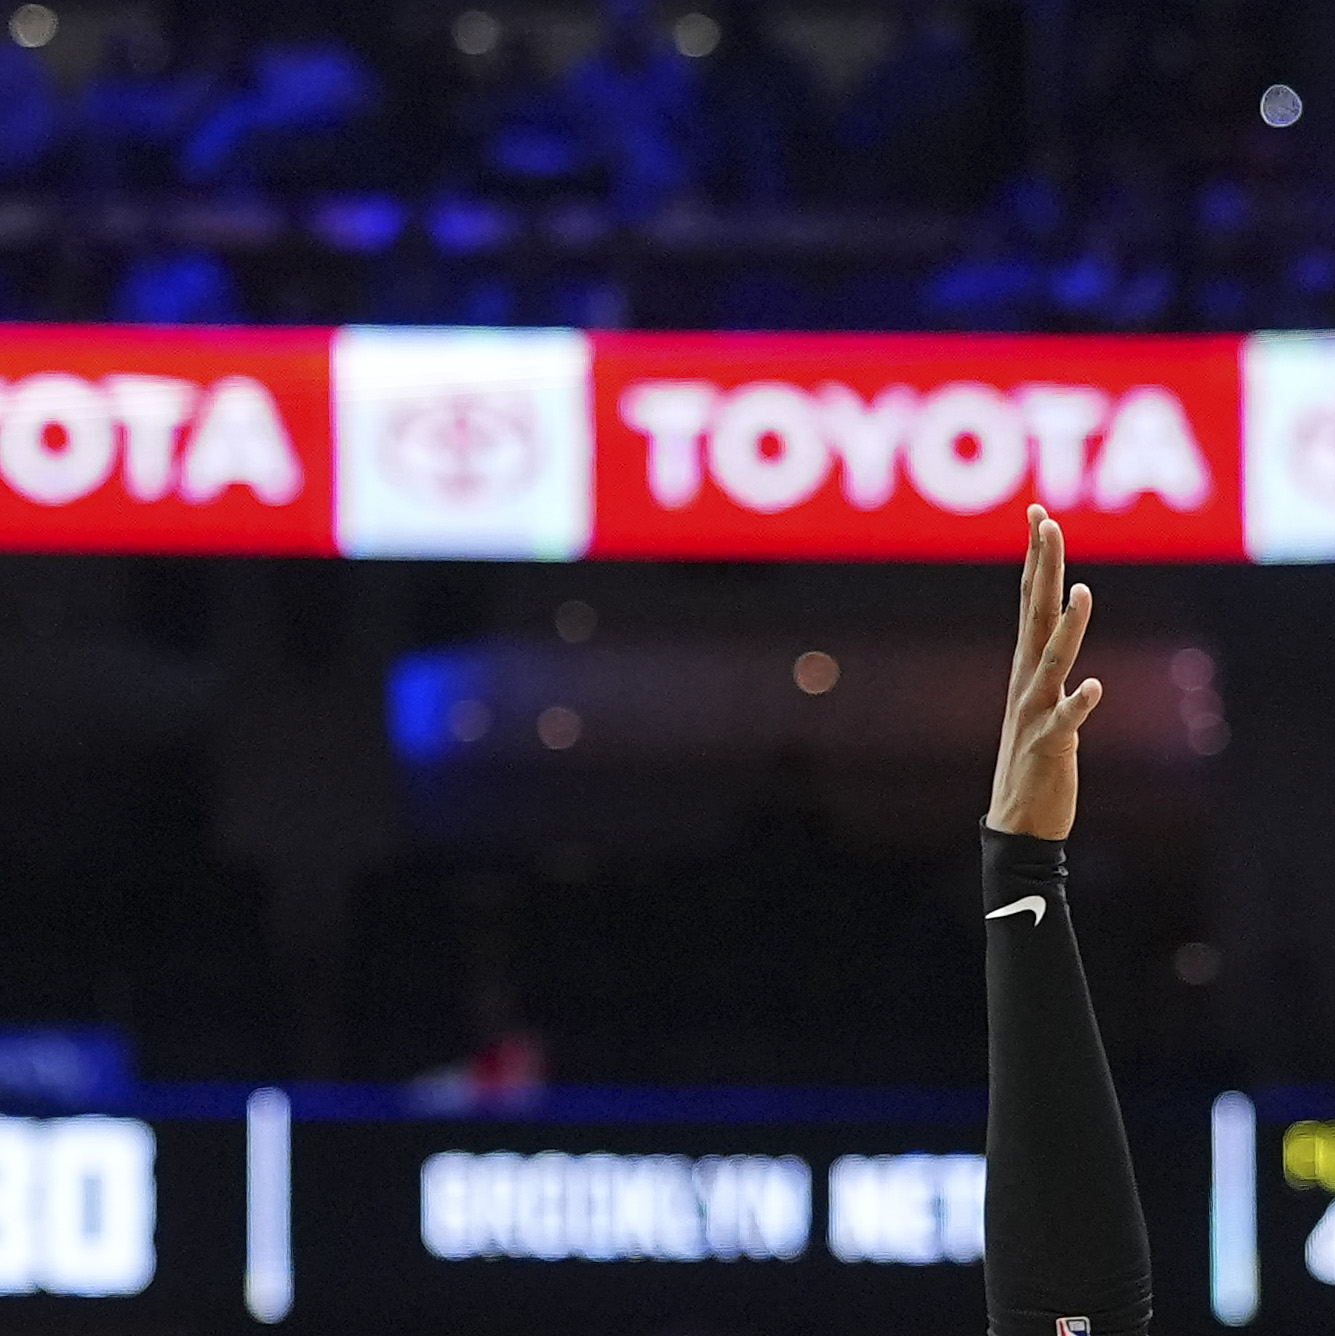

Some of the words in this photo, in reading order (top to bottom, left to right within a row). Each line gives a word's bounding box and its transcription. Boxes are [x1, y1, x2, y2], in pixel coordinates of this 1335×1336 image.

[0, 373, 299, 505] OTA
[620, 380, 1210, 512] TOYOTA
[828, 1153, 986, 1264] NET
